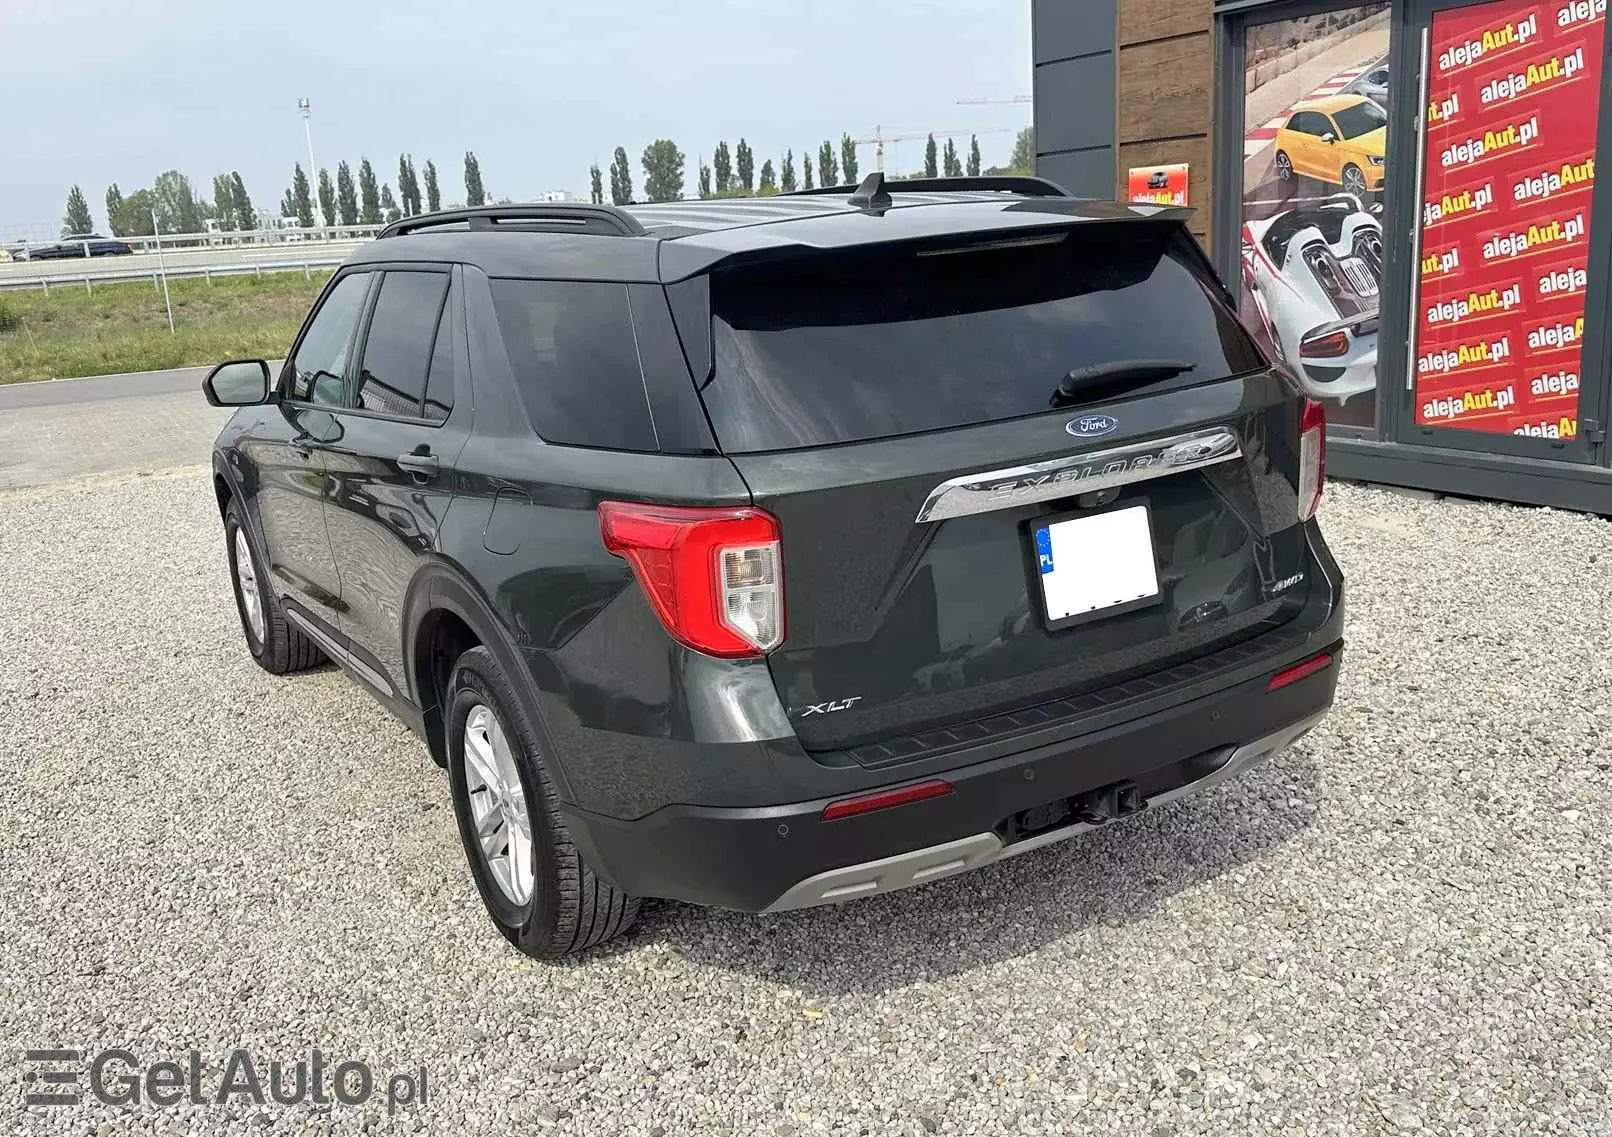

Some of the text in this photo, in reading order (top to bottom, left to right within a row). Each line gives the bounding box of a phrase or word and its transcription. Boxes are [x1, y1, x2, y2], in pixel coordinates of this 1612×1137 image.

[1439, 14, 1536, 70] alejaAut.pl
[1481, 48, 1584, 103] alejaAut.pl
[1441, 117, 1538, 166] alejaAut.pl
[1514, 158, 1595, 200] alejaAut
[1482, 214, 1585, 259] alejaAut.pl
[1539, 267, 1587, 294] aleja
[1427, 284, 1520, 323] alejaAut.pl
[1418, 337, 1510, 372] alejaAut.pl
[1423, 386, 1515, 418] alejaAut.pl
[1040, 553, 1053, 567] PL
[801, 696, 862, 717] XLT
